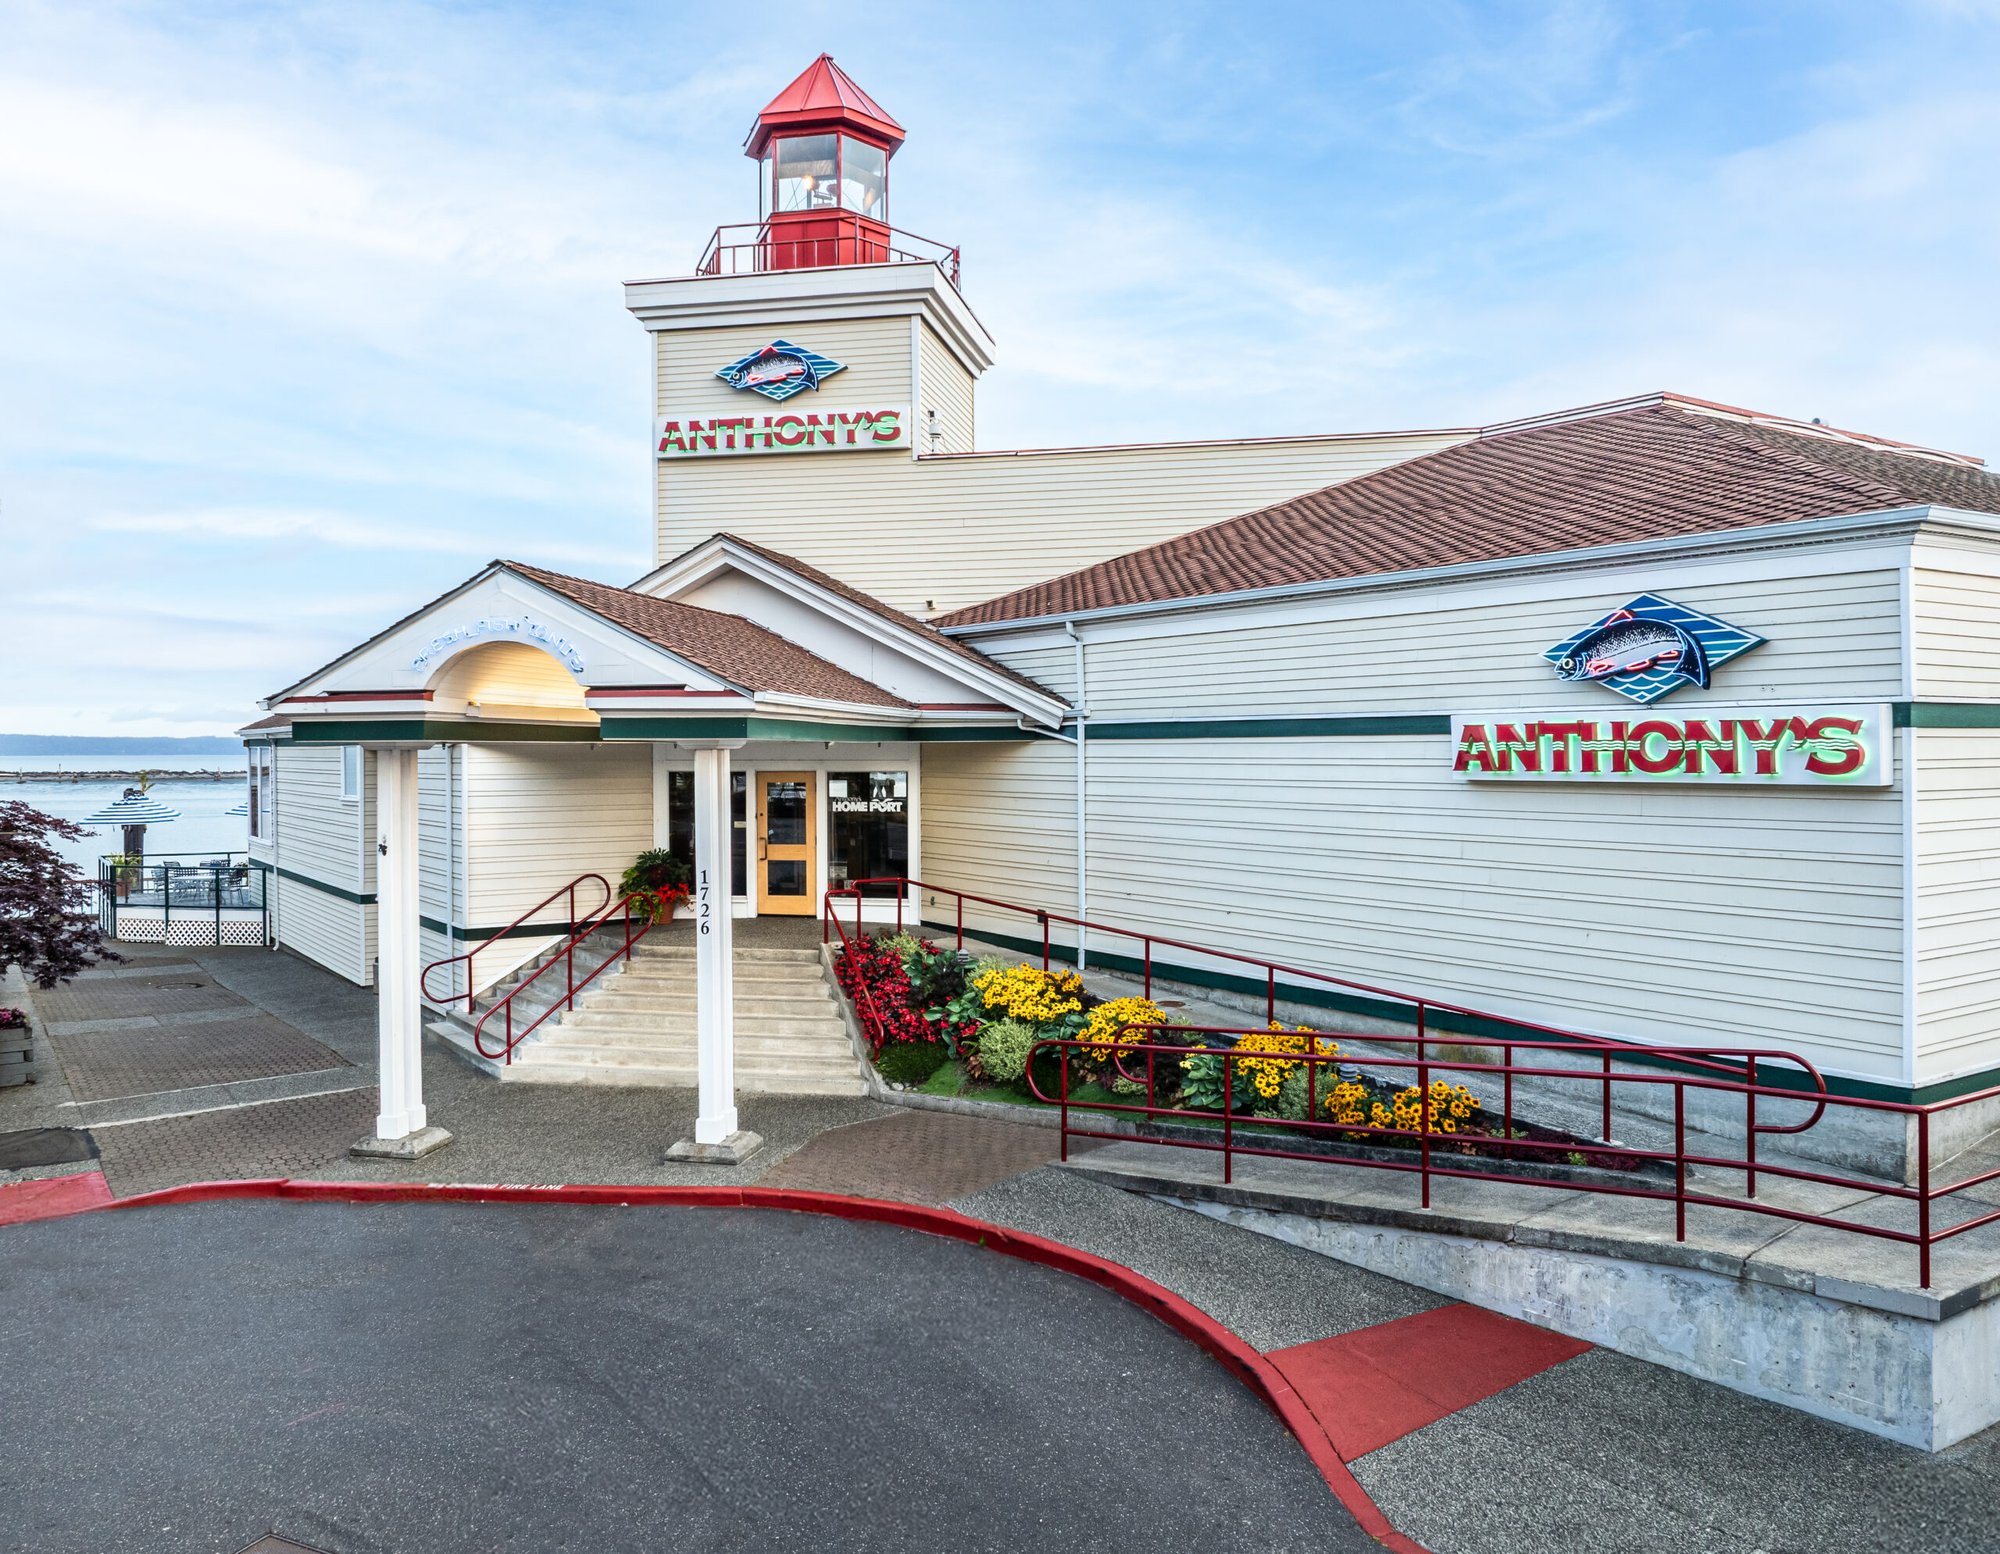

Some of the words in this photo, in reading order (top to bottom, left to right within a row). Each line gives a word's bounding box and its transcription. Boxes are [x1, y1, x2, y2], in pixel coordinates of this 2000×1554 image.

[658, 410, 901, 453] ANTHONY'S
[1453, 715, 1865, 776] ANTHONY'S
[832, 801, 868, 812] HOME
[869, 798, 903, 812] PORT
[700, 869, 710, 935] 1726
